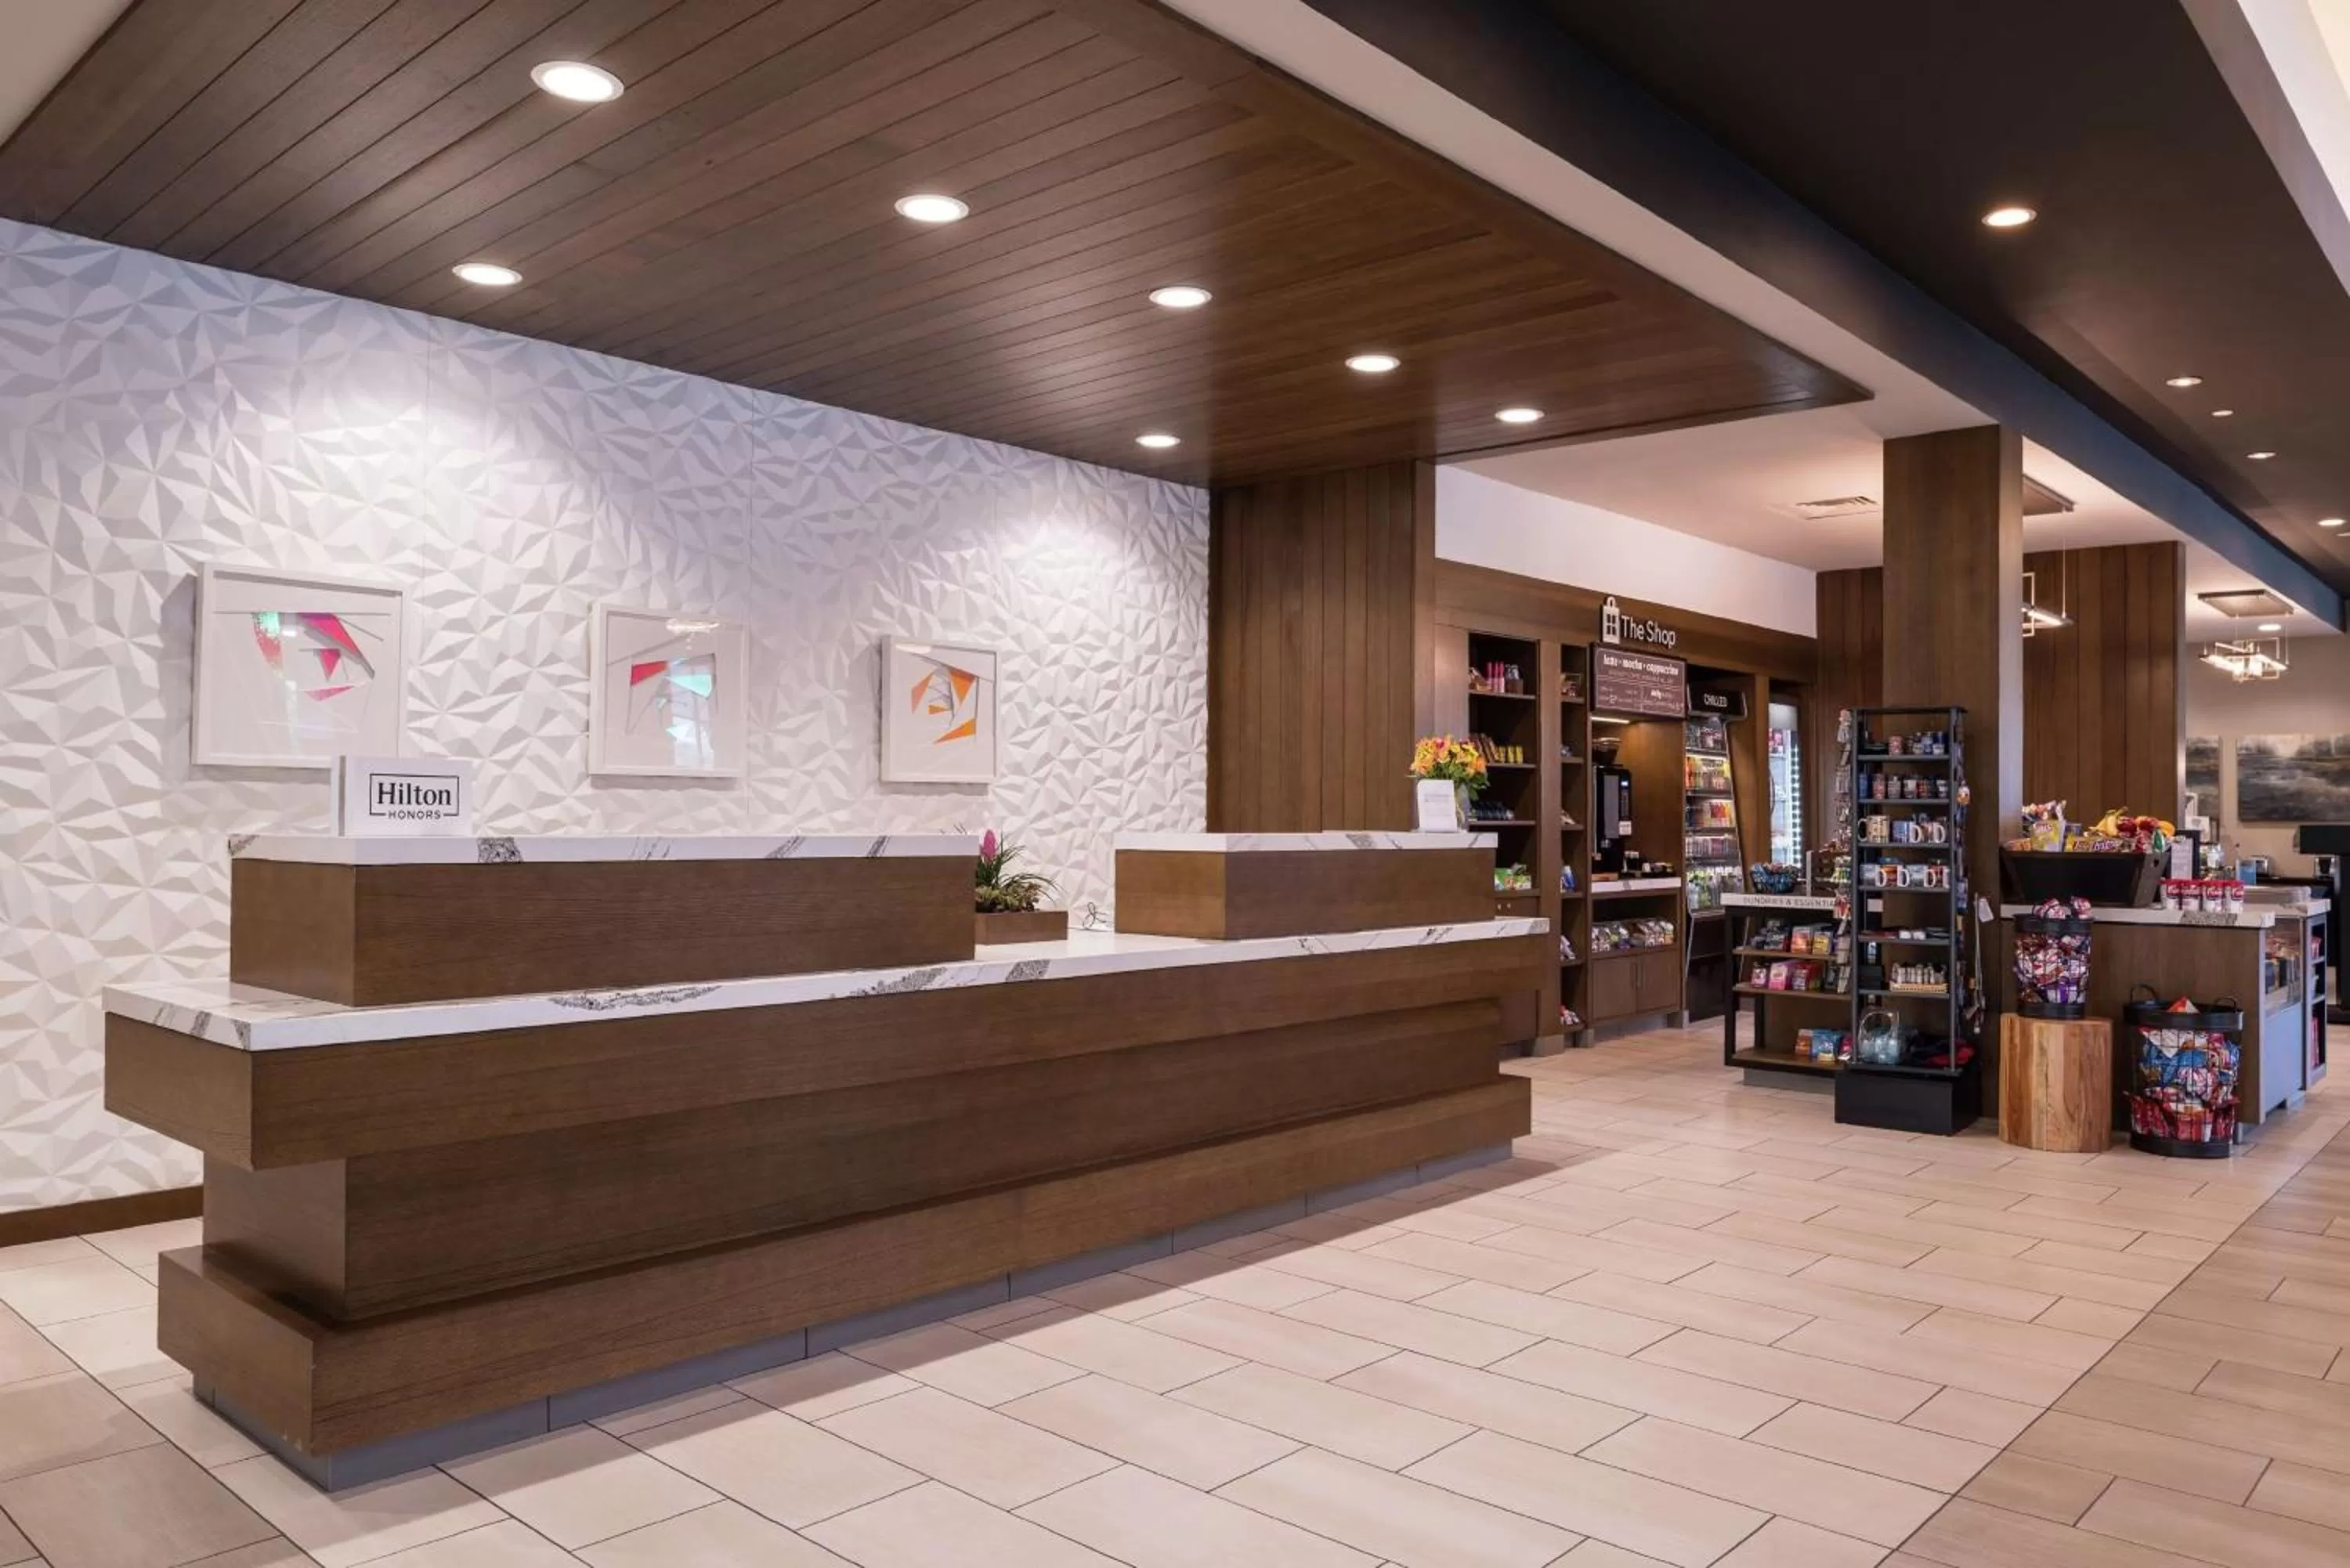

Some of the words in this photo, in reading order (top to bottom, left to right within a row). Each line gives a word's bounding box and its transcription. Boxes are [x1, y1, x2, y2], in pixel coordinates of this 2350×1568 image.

[1621, 614, 1644, 641] The
[1646, 620, 1676, 649] Shop
[377, 782, 452, 806] Hilton
[388, 809, 441, 820] HONORS
